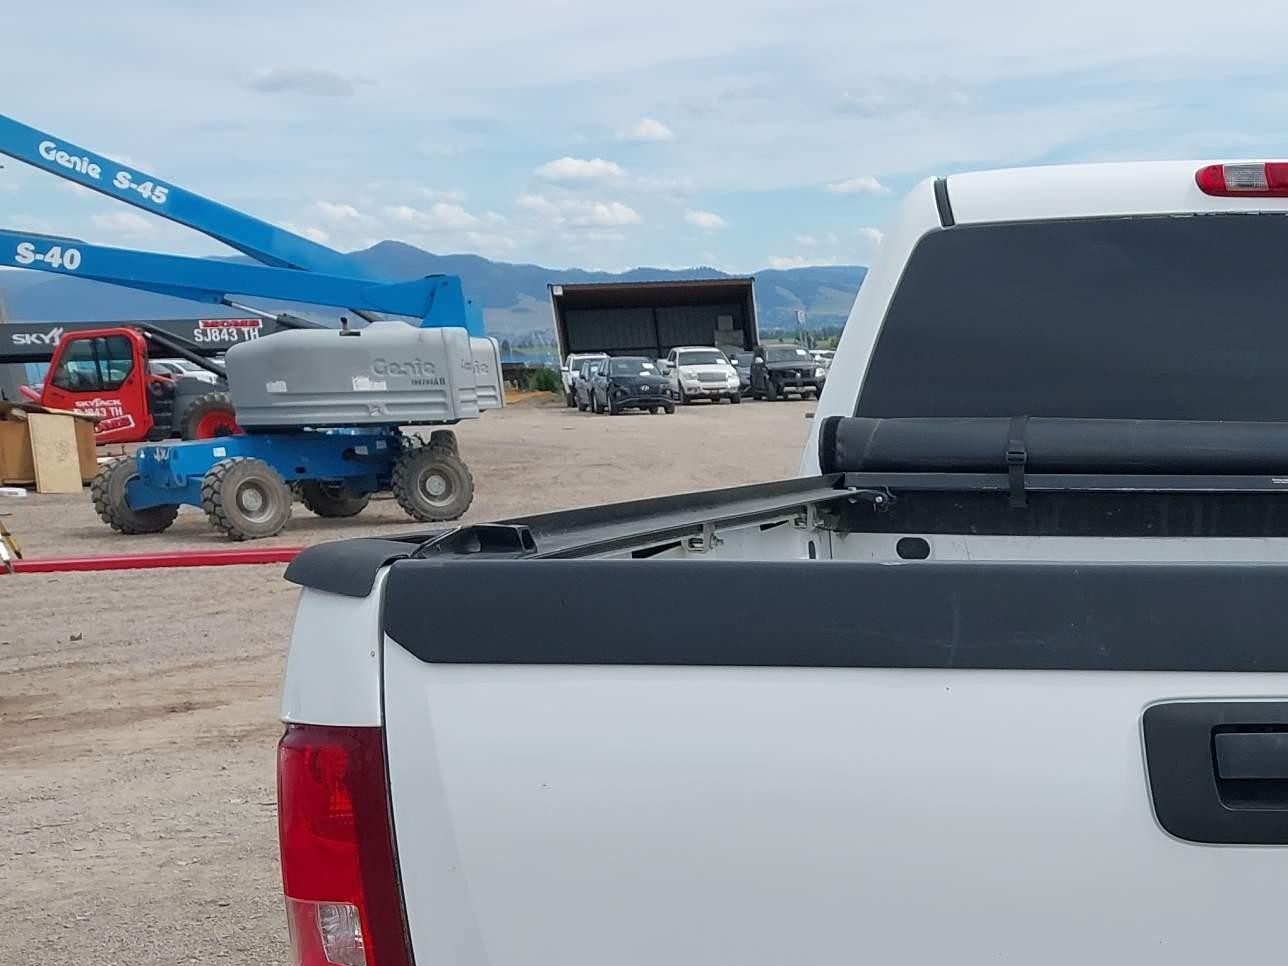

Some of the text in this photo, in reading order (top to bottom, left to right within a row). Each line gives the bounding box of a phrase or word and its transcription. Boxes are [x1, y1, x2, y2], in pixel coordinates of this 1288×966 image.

[39, 141, 168, 203] Genie S-45
[15, 242, 81, 270] S-40
[193, 327, 259, 341] SJ843 TH
[370, 357, 436, 377] Genie
[75, 398, 121, 407] SKYJACK
[109, 406, 123, 416] TH
